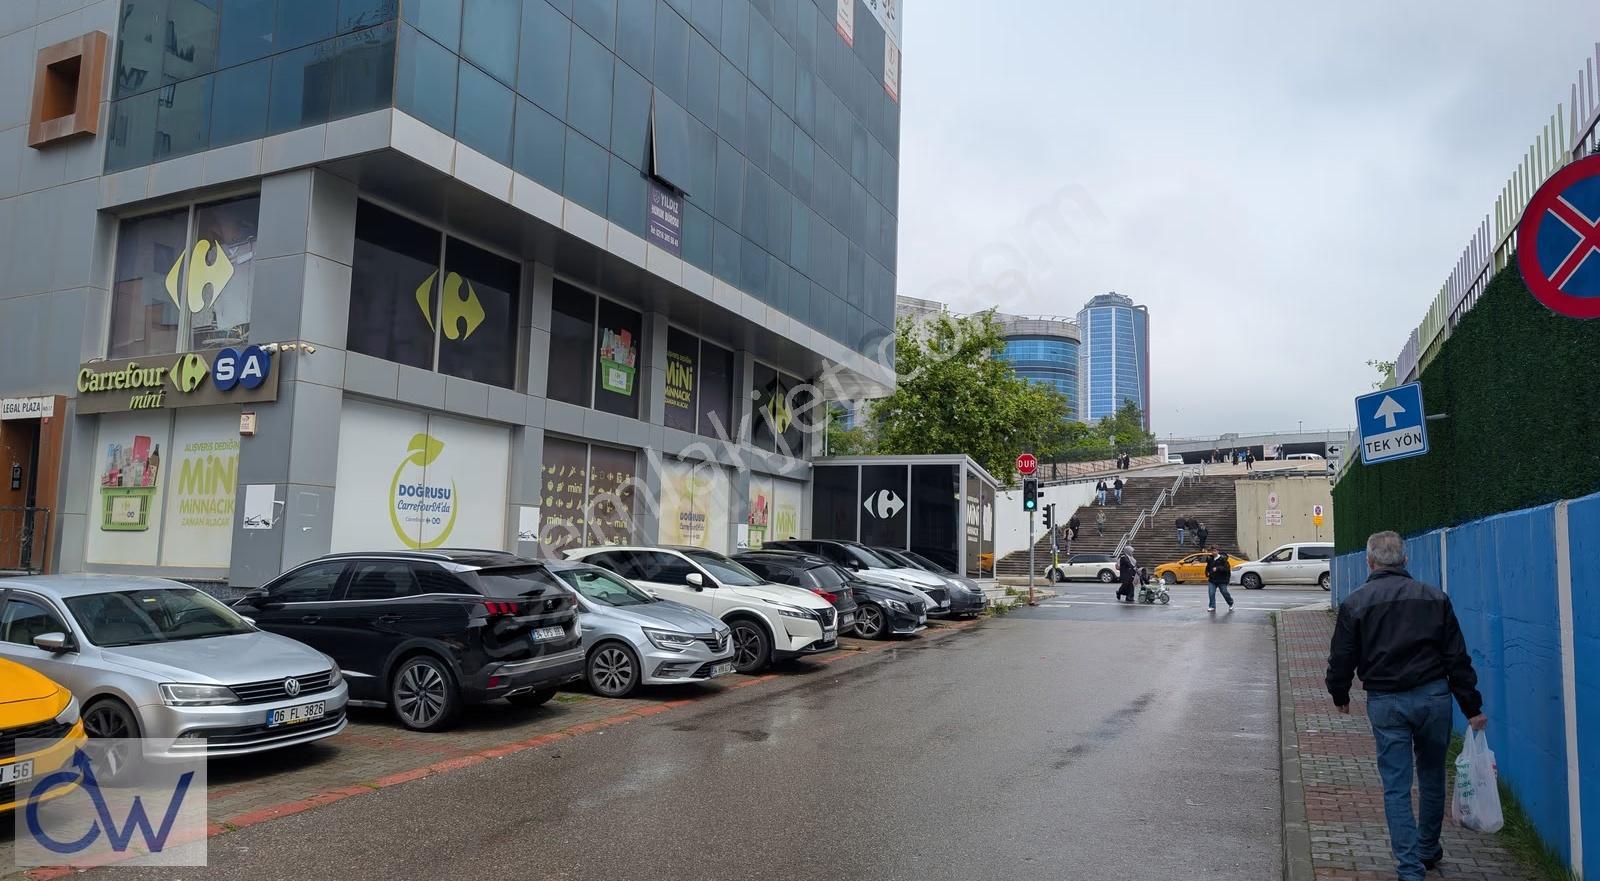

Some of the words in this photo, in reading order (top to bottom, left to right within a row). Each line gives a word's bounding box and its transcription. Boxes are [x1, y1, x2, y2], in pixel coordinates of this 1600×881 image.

[660, 192, 679, 214] YILDIZ
[77, 362, 166, 393] Carrefour
[216, 355, 262, 381] SA
[3, 403, 21, 413] LEGAL
[22, 402, 40, 412] PLAZA
[129, 391, 164, 410] mini
[1366, 439, 1391, 453] TEK
[1395, 432, 1422, 448] YÖN
[1018, 460, 1035, 468] DUR
[398, 483, 451, 499] DOĞRUSU
[567, 482, 583, 493] mini
[274, 710, 285, 722] 06
[290, 708, 300, 720] FL
[304, 703, 323, 717] 3826
[13, 762, 29, 779] 56
